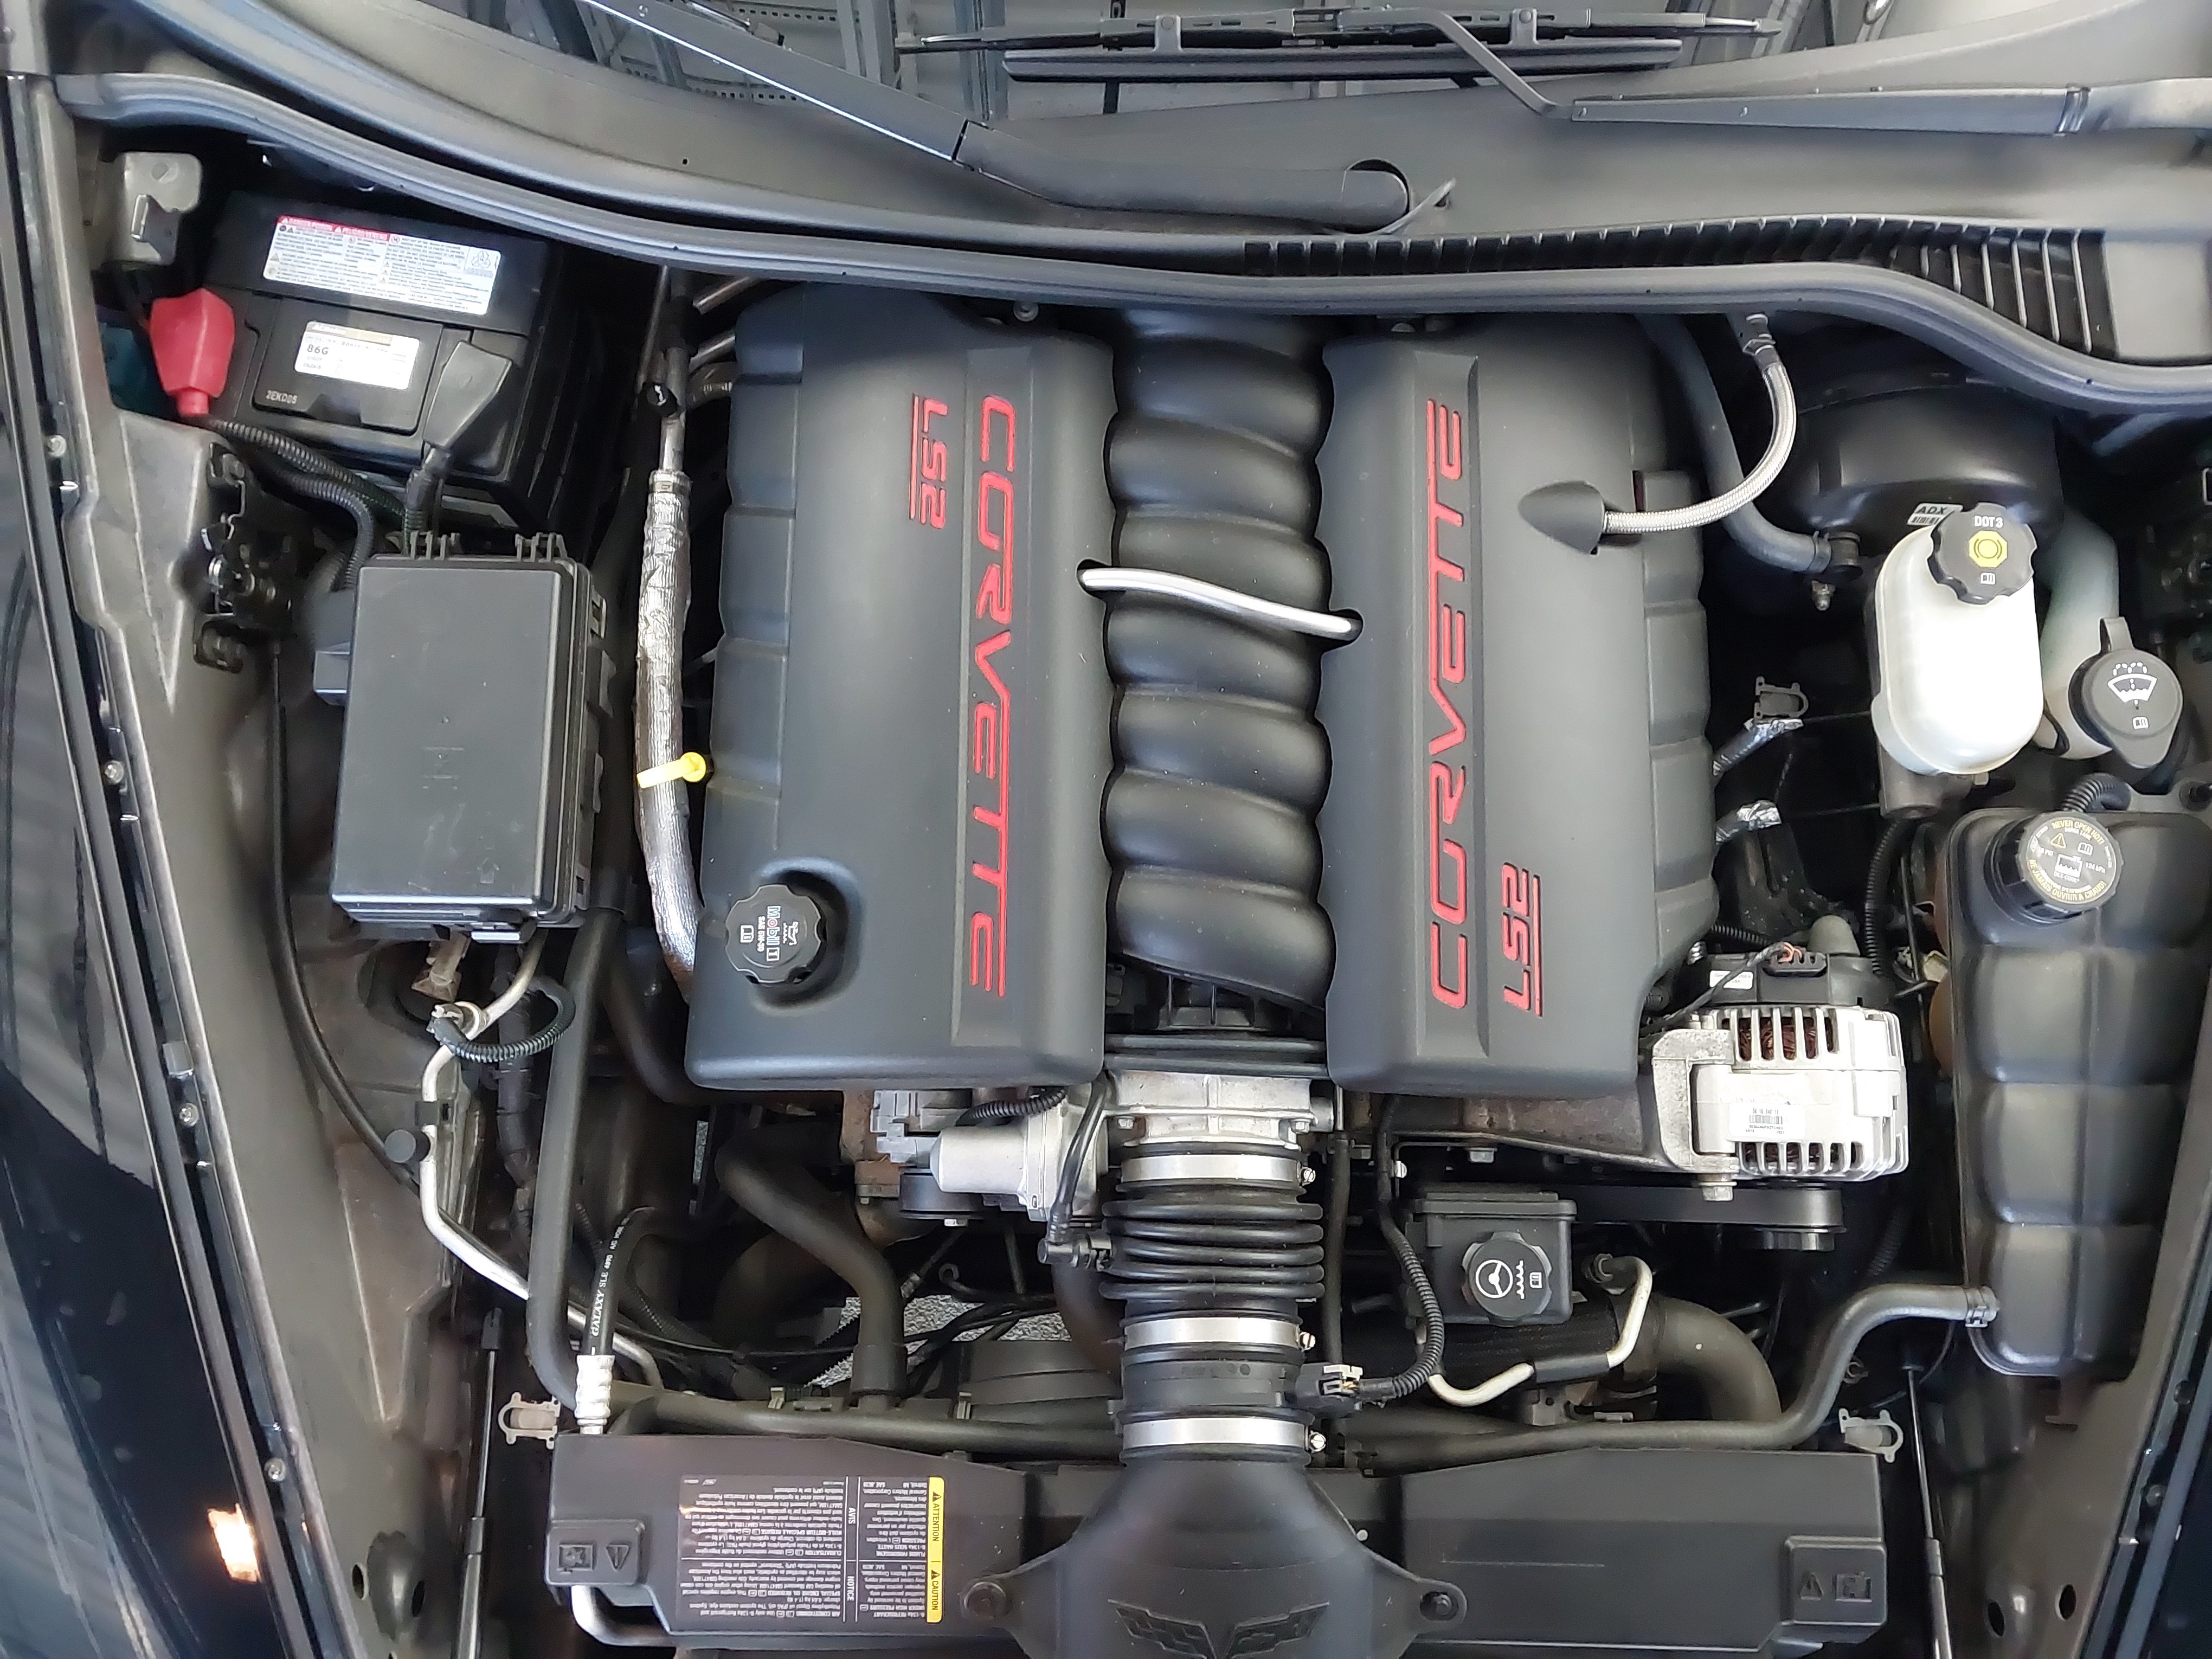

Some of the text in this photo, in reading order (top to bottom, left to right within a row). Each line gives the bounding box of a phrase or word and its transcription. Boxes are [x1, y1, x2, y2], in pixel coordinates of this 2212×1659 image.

[307, 344, 329, 355] 86G
[920, 399, 948, 529] LS2
[1917, 505, 1948, 515] ADX
[1973, 515, 2004, 528] DOT 3
[971, 396, 1015, 997] CORVETTE
[1427, 402, 1466, 1007] CORVETTE
[2052, 820, 2105, 845] NEVER OPEN HOT!
[757, 916, 766, 953] SAE 5W-30
[766, 905, 781, 946] Mobil
[1502, 865, 1530, 1009] LS2
[591, 1290, 605, 1336] GALAXY
[848, 1507, 856, 1525] AVIS
[847, 1576, 855, 1602] NOTICE
